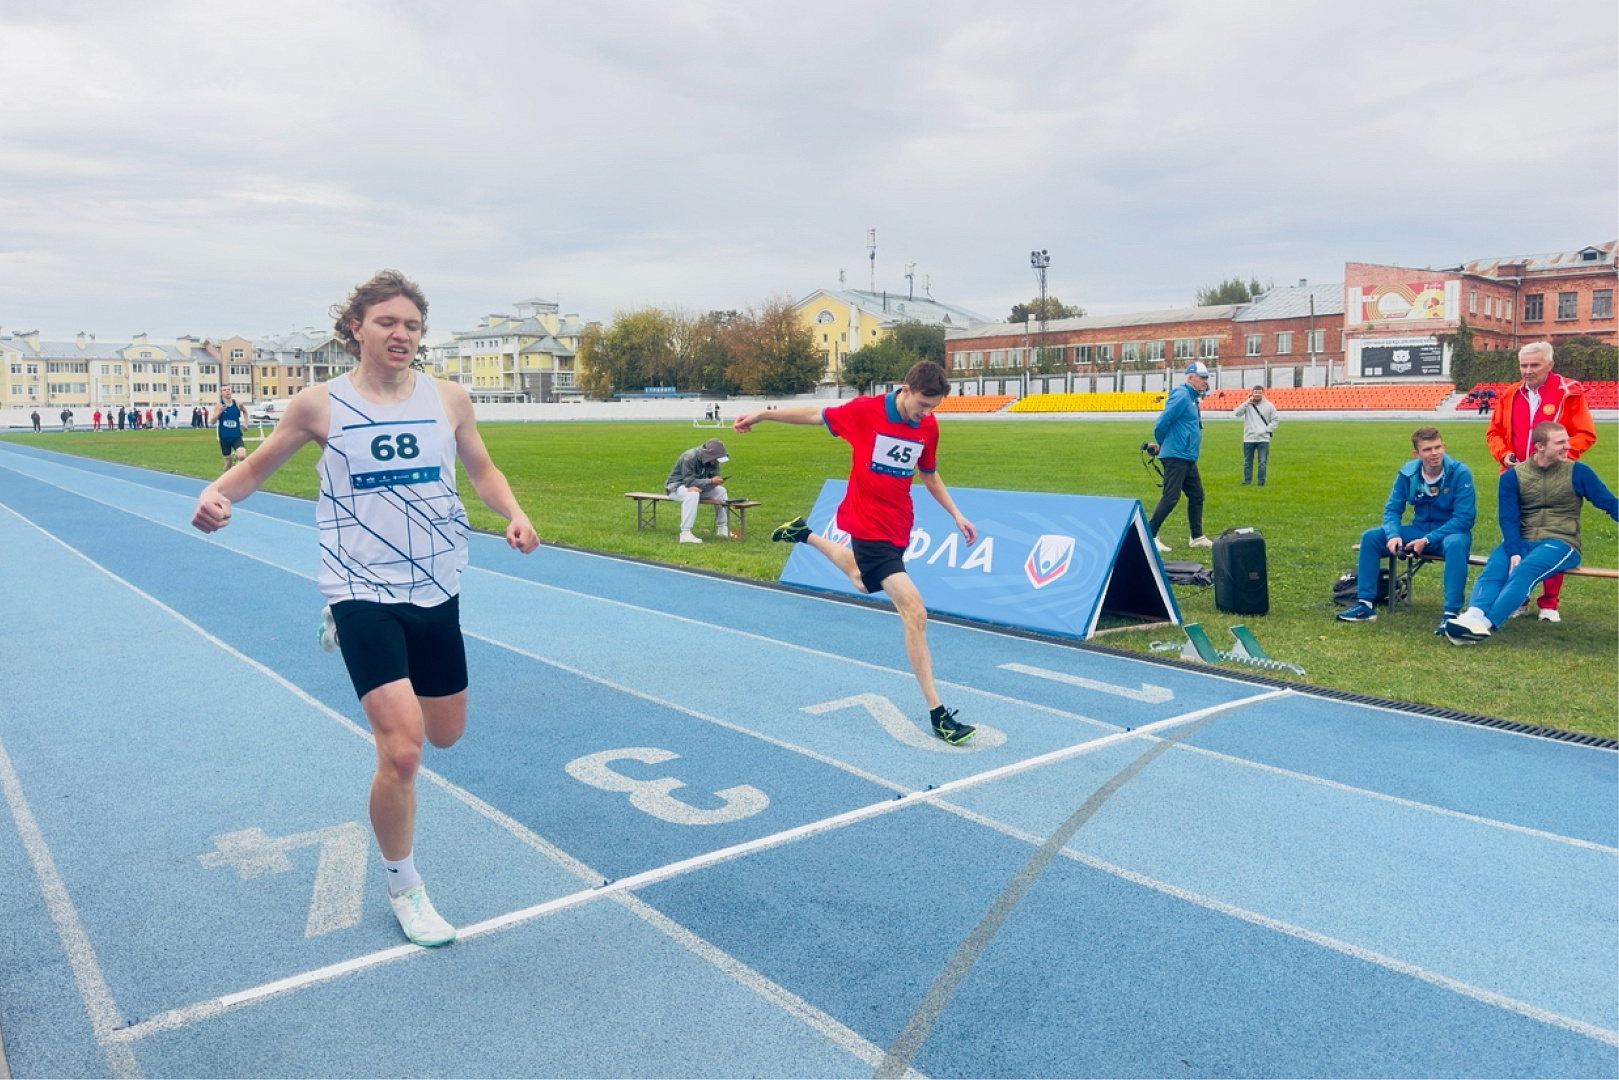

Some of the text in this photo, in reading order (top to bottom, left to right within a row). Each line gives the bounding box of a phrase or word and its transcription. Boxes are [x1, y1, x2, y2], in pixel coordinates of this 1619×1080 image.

[371, 433, 420, 461] 68
[887, 445, 912, 463] 45
[996, 662, 1174, 704] 1
[799, 693, 1007, 753] 2
[564, 747, 770, 825] 3
[196, 821, 370, 938] 4
